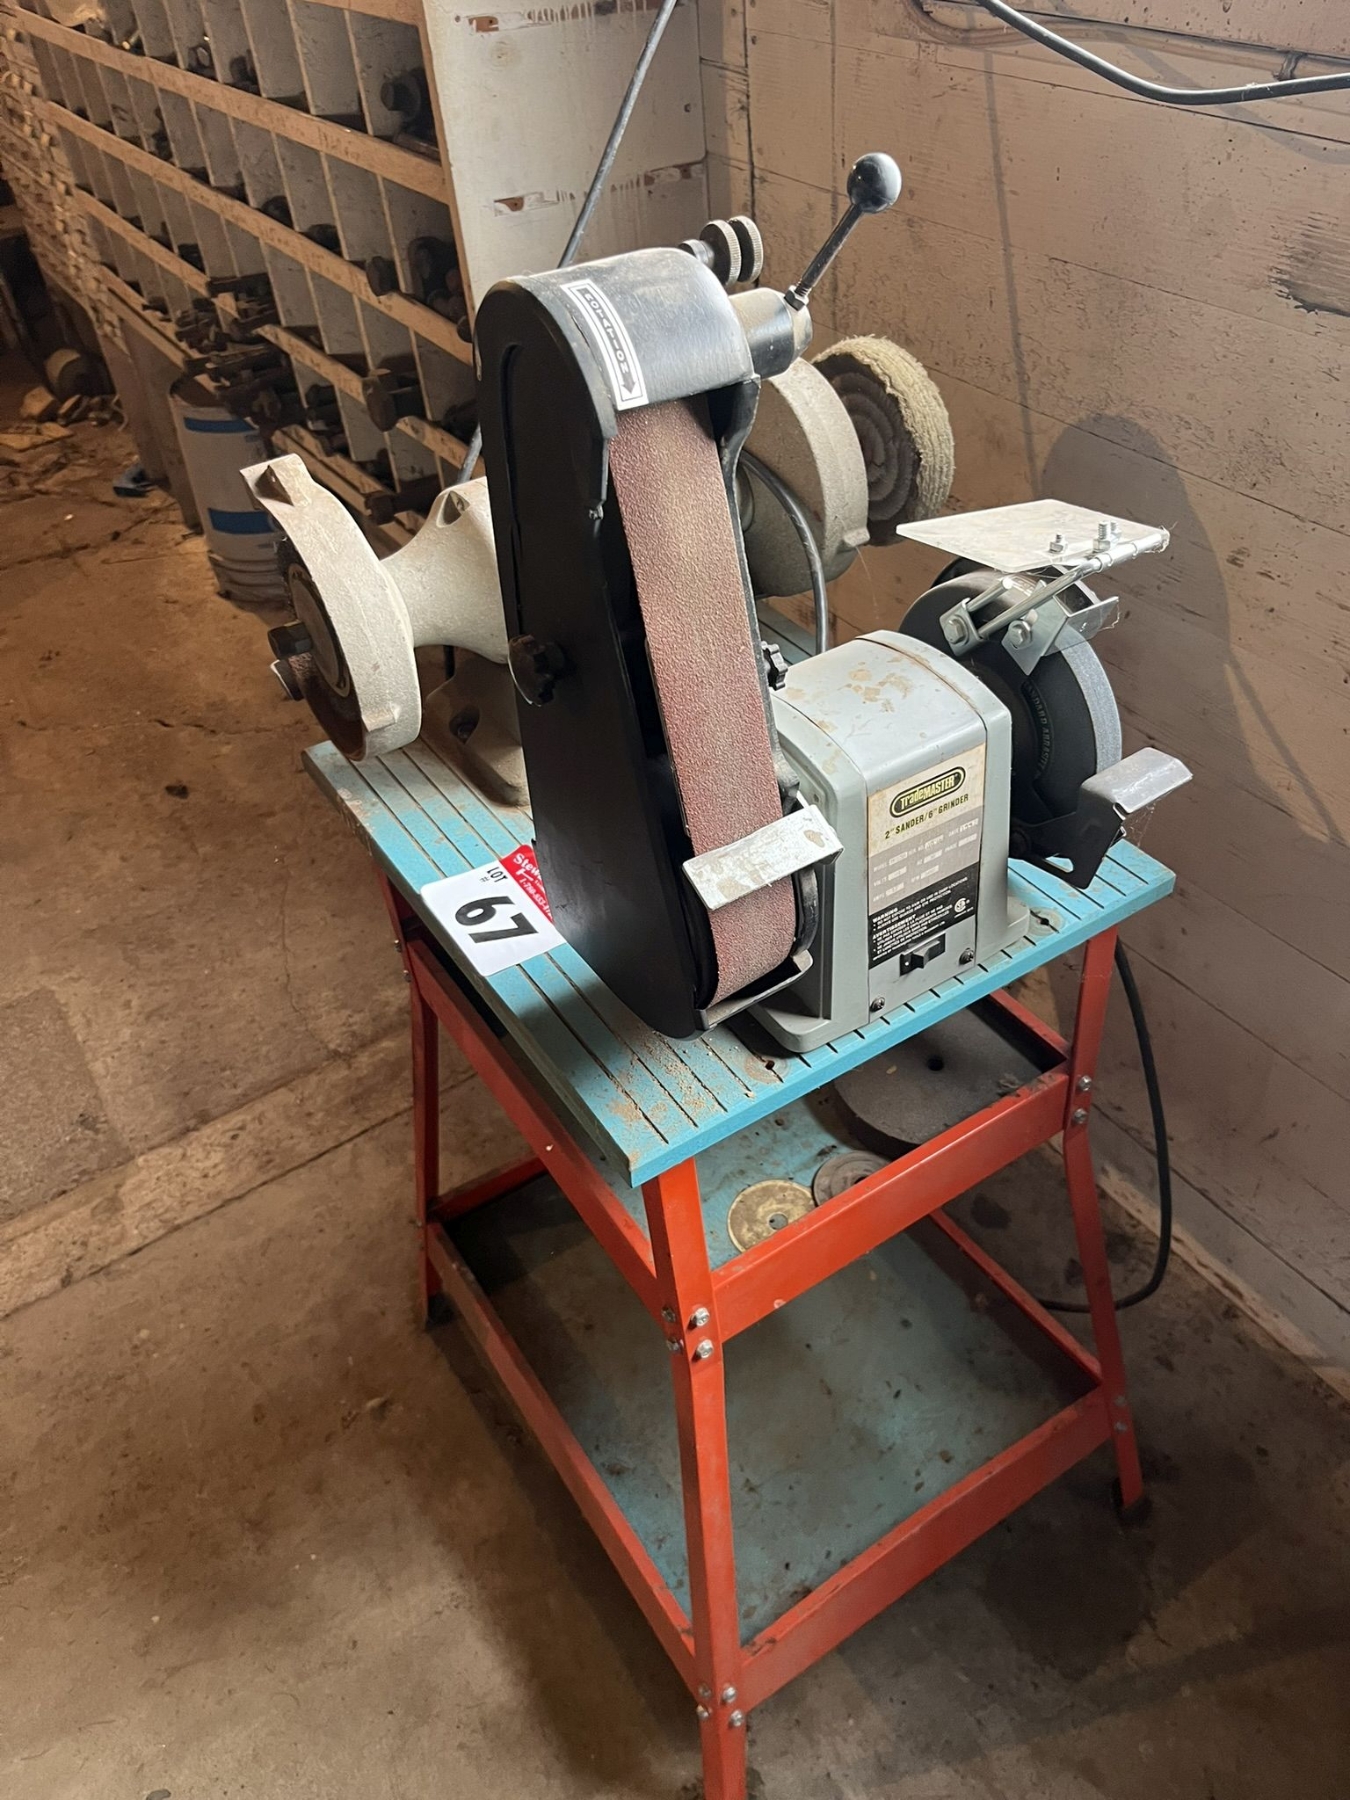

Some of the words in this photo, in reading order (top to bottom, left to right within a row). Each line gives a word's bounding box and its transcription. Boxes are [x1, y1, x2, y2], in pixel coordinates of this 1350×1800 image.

[584, 293, 629, 373] ROTATION
[938, 793, 969, 814] GRINDER
[487, 866, 509, 883] LOT
[454, 895, 539, 944] 67
